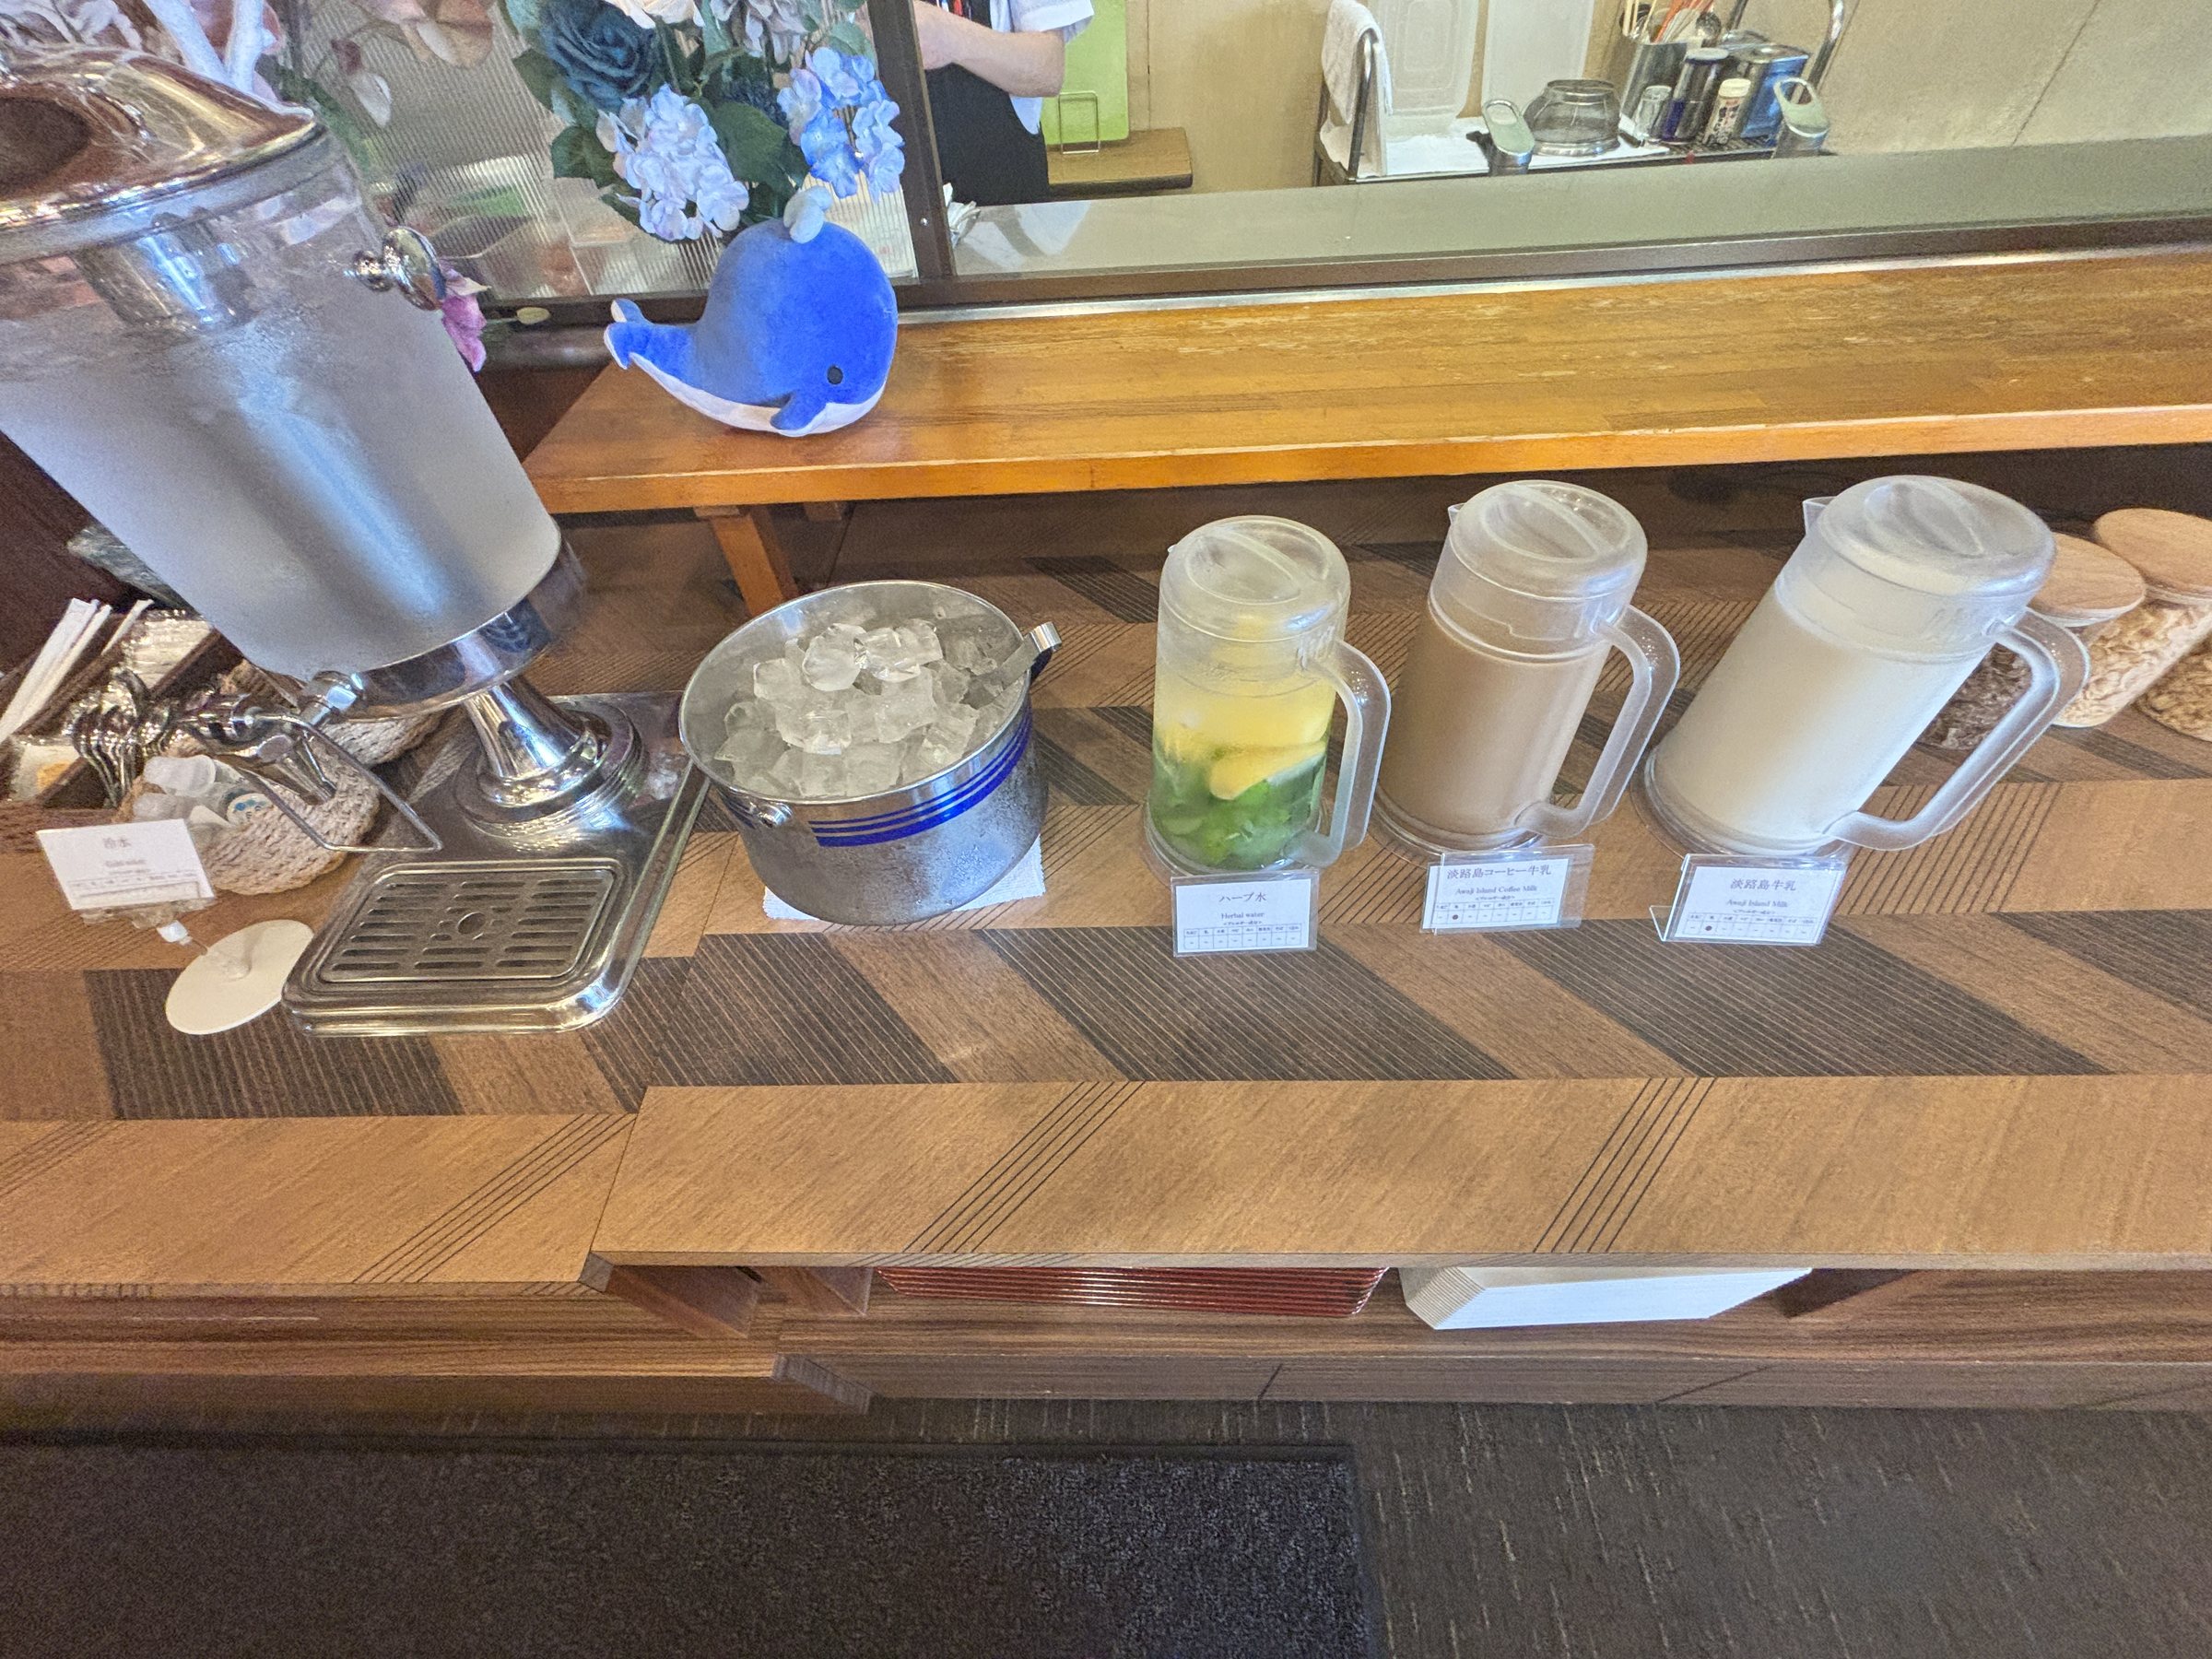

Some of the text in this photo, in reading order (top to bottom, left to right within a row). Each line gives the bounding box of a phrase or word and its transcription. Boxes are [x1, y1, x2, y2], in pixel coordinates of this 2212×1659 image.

[1447, 865, 1552, 879] 淡路島コーヒー牛乳
[1730, 878, 1796, 891] 淡路島牛乳
[1221, 911, 1265, 921] Herbal water
